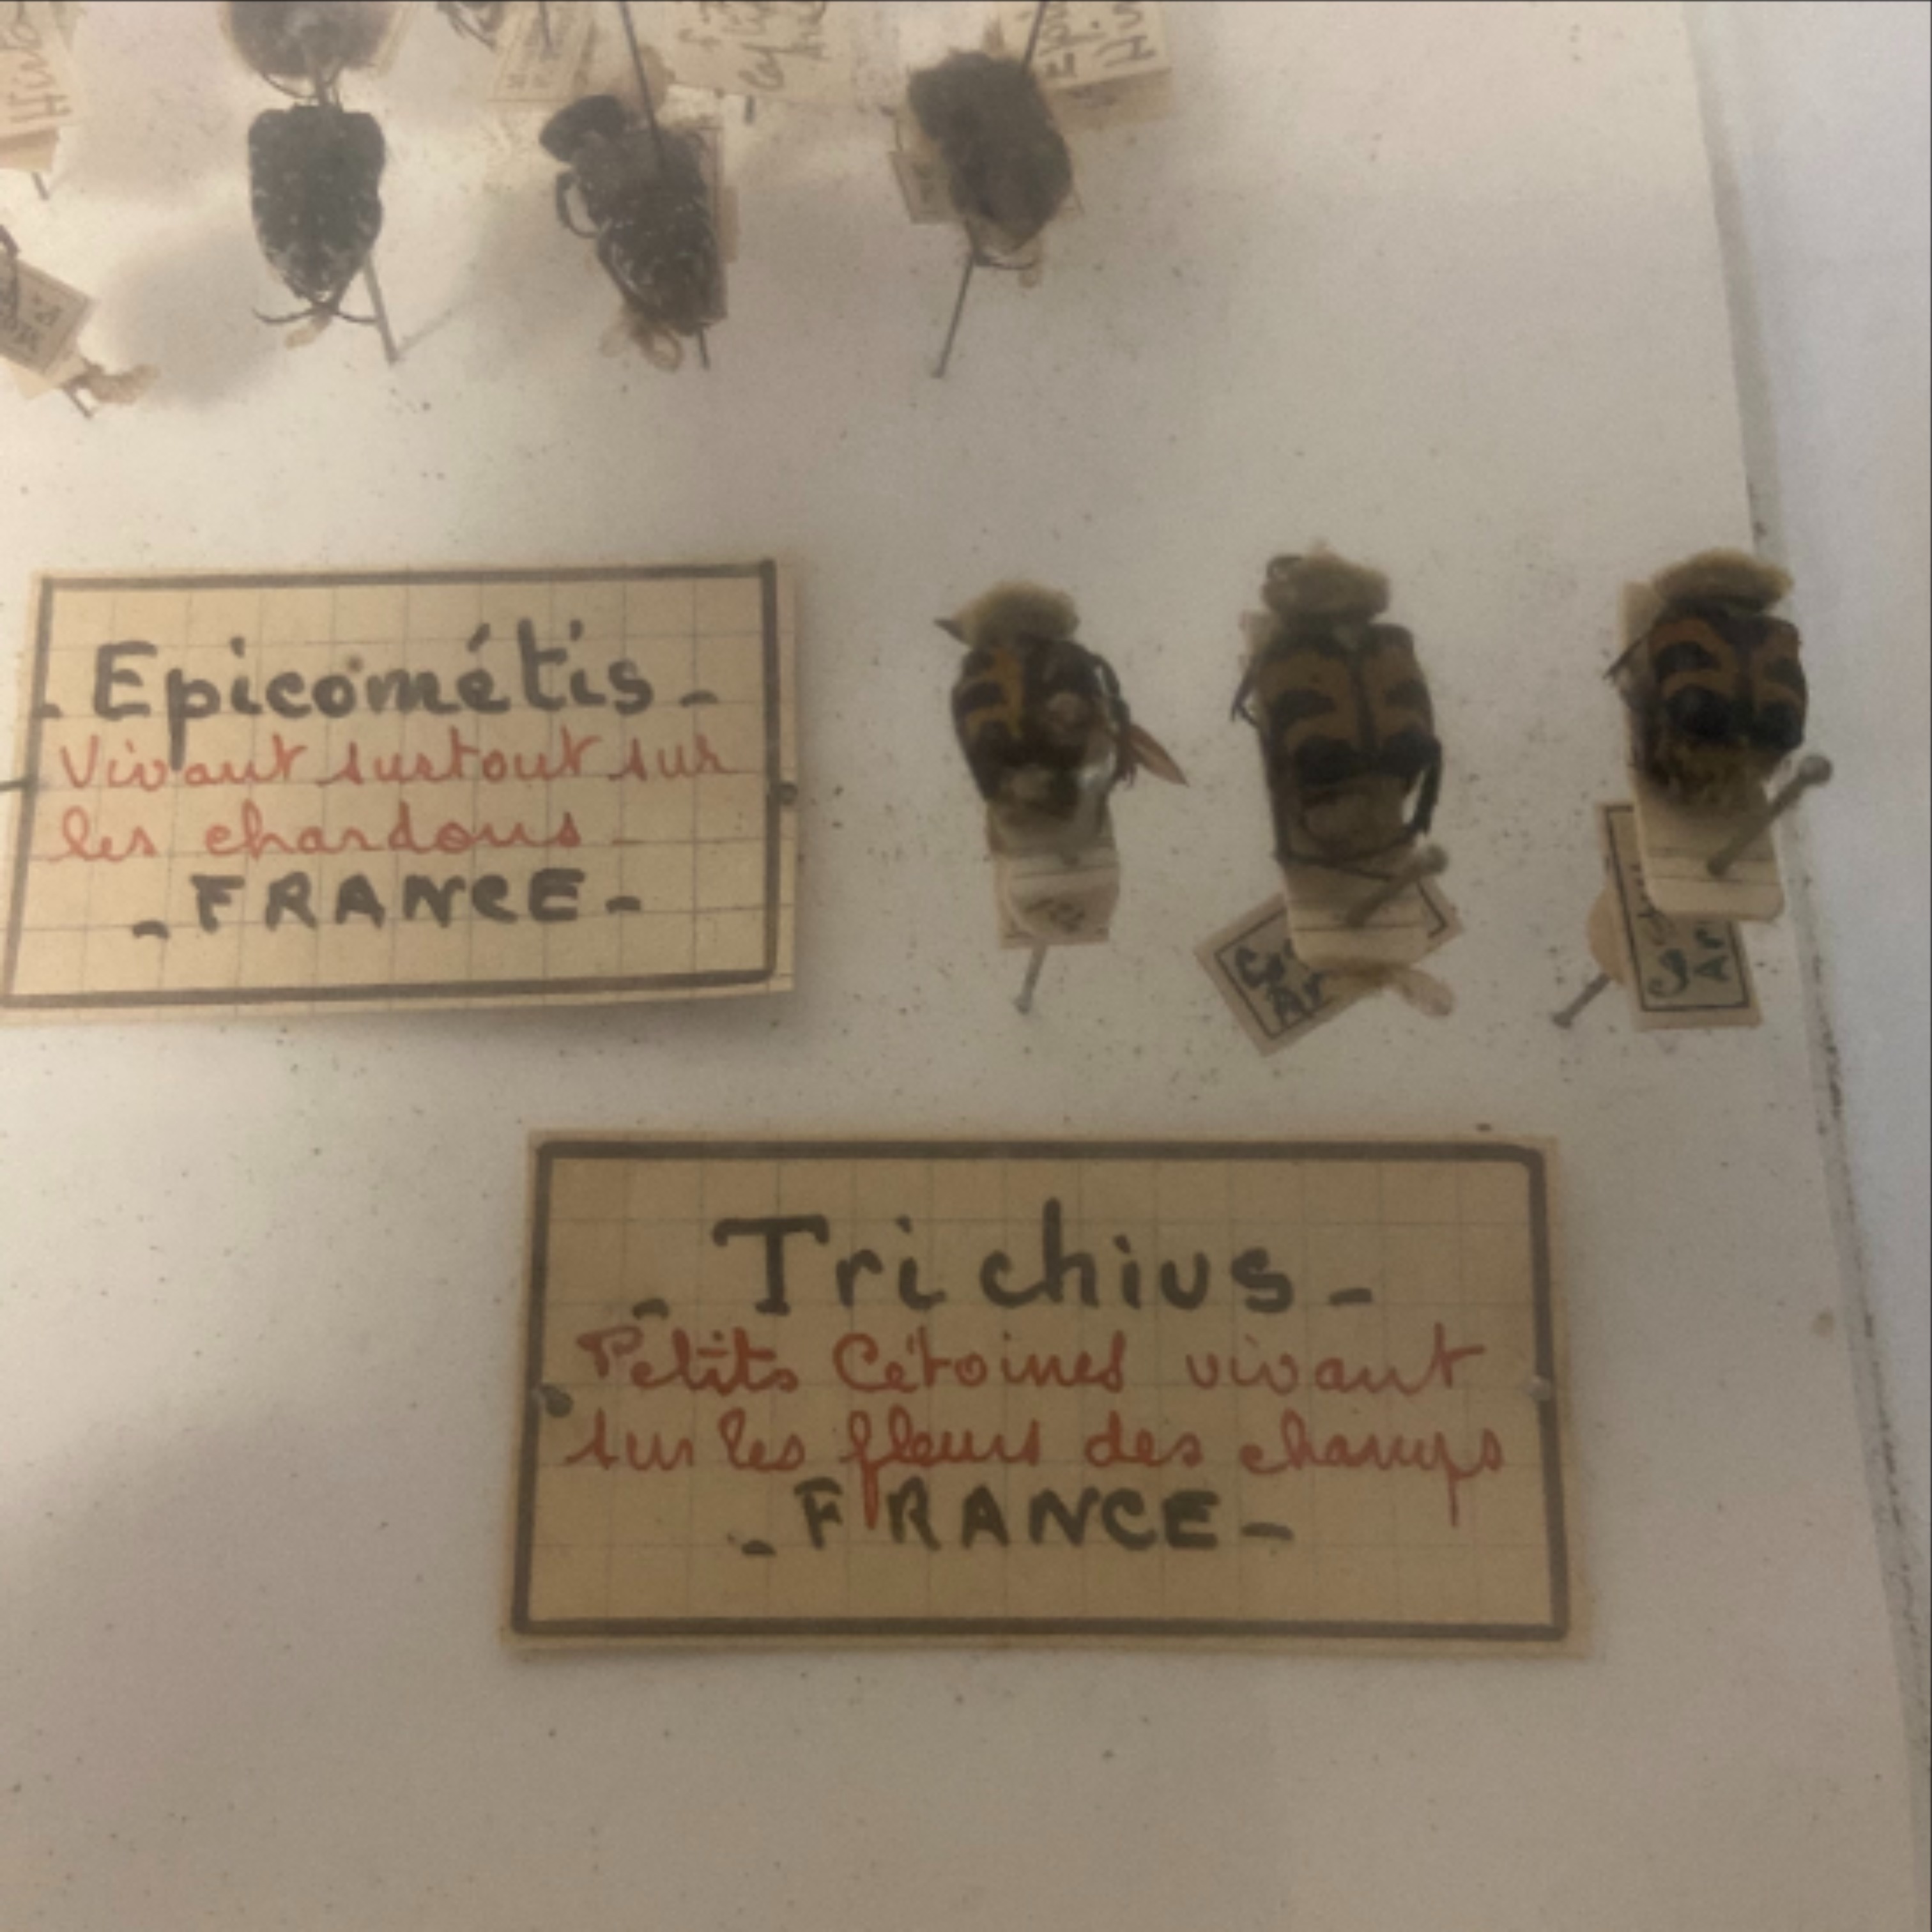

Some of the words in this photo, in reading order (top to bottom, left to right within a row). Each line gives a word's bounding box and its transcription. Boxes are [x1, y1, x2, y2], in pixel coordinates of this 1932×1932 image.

[93, 617, 654, 770] Epicométis
[61, 733, 308, 792] Vivant
[315, 726, 601, 787] surtout
[608, 733, 735, 783] sur
[48, 805, 157, 863] les
[203, 799, 583, 861] chardons
[190, 867, 586, 933] FRANCE
[575, 1324, 799, 1396] Petits
[1185, 1321, 1487, 1396] vivant
[564, 1407, 694, 1472] sur
[717, 1407, 806, 1473] les
[838, 1403, 1041, 1530] fleurs
[1084, 1409, 1203, 1469] des
[1239, 1407, 1505, 1528] champs
[792, 1475, 1221, 1552] FRANCE
